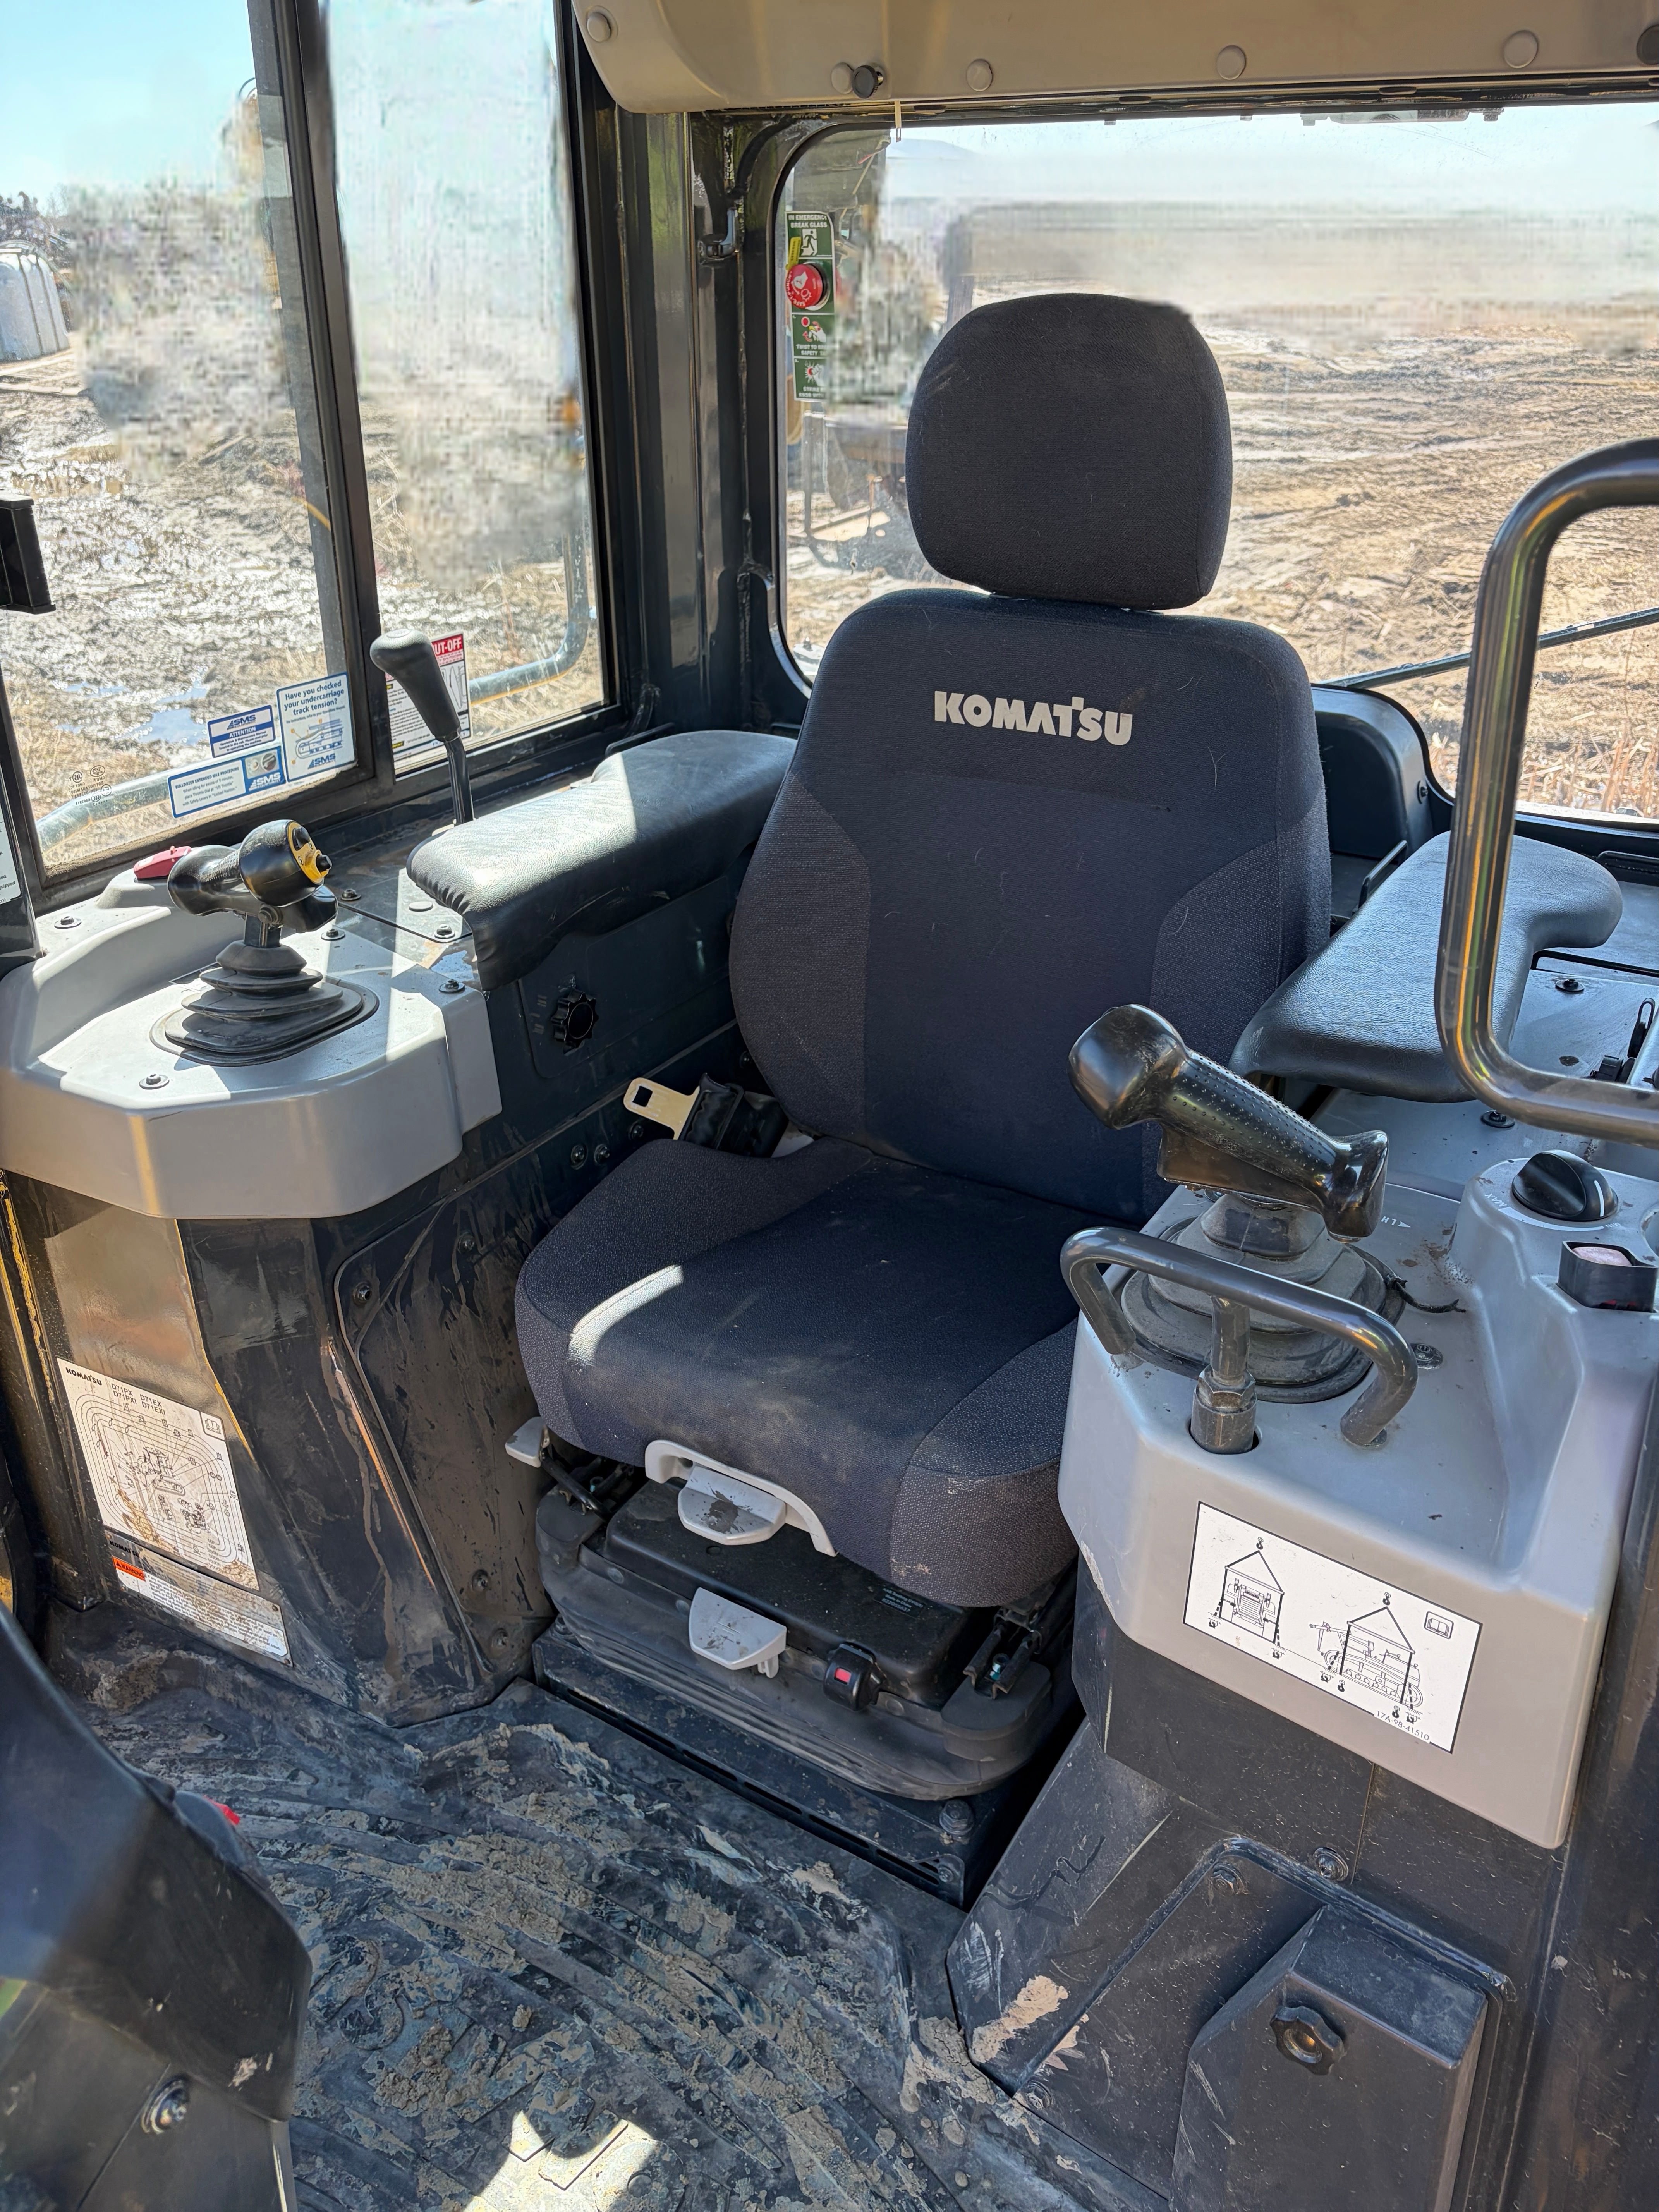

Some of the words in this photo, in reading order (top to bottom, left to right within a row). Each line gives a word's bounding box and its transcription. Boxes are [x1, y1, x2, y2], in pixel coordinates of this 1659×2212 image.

[433, 637, 462, 655] UT-OFF
[285, 692, 301, 700] Have
[303, 689, 315, 697] you
[316, 680, 342, 692] checked
[284, 701, 299, 711] your
[301, 689, 344, 705] undercarriage
[293, 706, 309, 716] track
[311, 698, 337, 711] tension?
[234, 714, 256, 725] SMS
[934, 690, 1133, 745] KOMATSU
[229, 726, 256, 738] ATTENTION
[314, 753, 336, 764] SMS
[175, 779, 194, 789] BULLDOZER
[195, 775, 212, 783] EXTENDED
[220, 767, 239, 776] PROCEDURE
[257, 772, 281, 785] SMS
[1484, 1194, 1507, 1207] MAX
[1381, 1216, 1397, 1225] LH
[65, 1367, 102, 1386] KOMATSU
[111, 1383, 133, 1396] D71PX
[140, 1394, 162, 1408] D71EX
[113, 1391, 137, 1405] D71PXI
[141, 1401, 166, 1415] D71EXI
[120, 1563, 144, 1578] WARNING
[1377, 1710, 1429, 1741] 17A-98-41510
